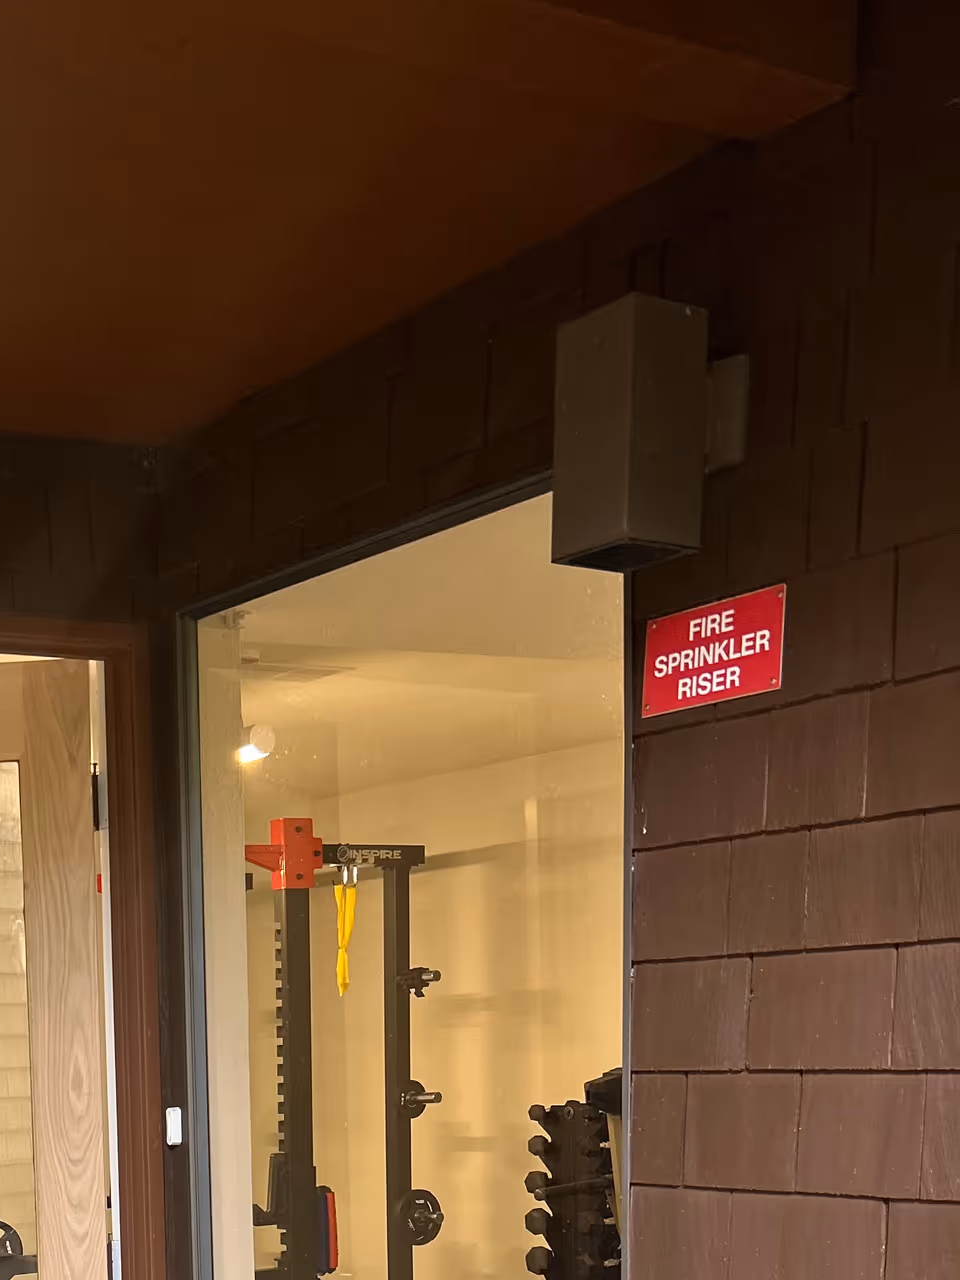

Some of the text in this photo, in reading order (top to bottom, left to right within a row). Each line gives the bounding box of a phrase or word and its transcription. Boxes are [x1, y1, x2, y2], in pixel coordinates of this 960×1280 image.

[689, 609, 735, 641] FIRE
[654, 629, 771, 678] SPRINKLER
[678, 666, 741, 700] RISER
[350, 849, 402, 859] INSPIRE
